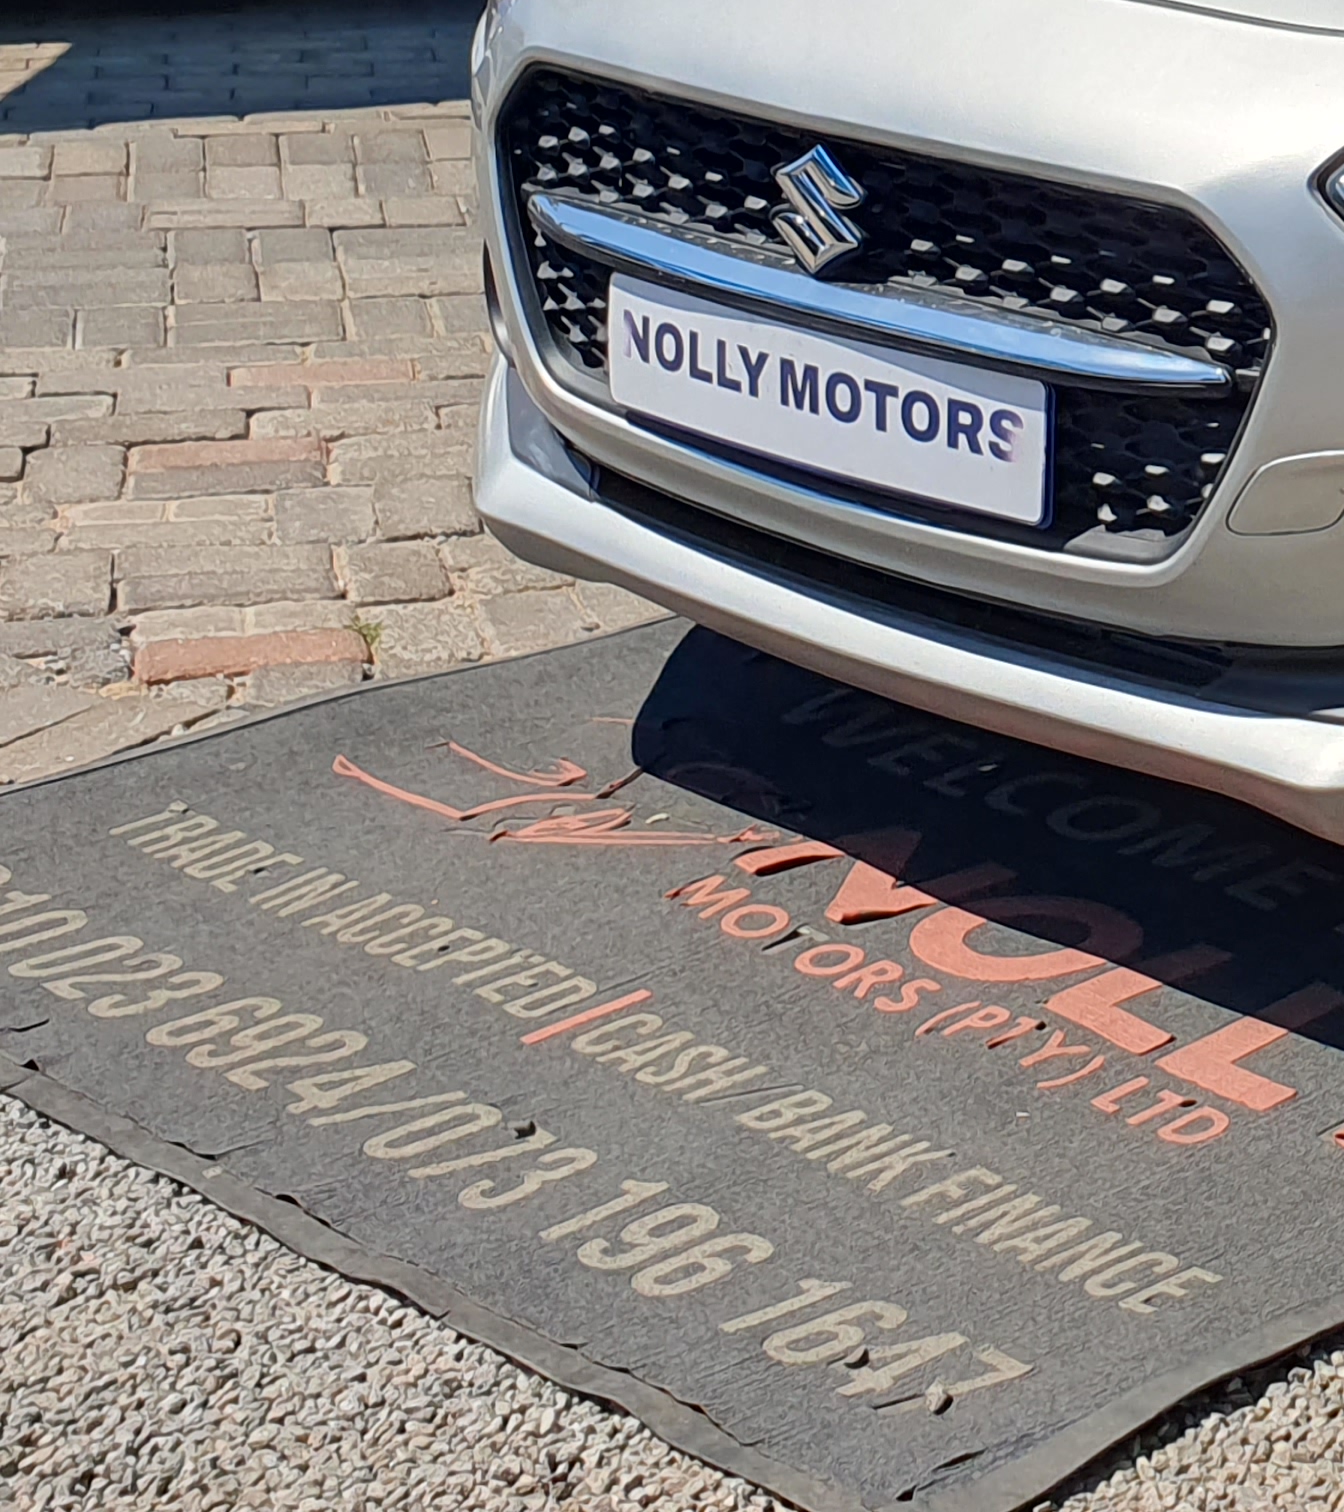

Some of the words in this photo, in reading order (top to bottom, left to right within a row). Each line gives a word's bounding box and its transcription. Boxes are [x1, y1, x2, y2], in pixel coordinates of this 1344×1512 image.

[622, 308, 768, 400] NOLLY
[778, 357, 1025, 464] MOTORS
[108, 799, 304, 893] TRADE
[781, 688, 1343, 911] WELCOME
[249, 866, 361, 918] IN
[300, 891, 598, 1019] ACCEPTED
[664, 874, 943, 1014] MOTORS
[914, 1001, 1106, 1089] (PTY)
[1090, 1076, 1230, 1144] LTD
[7, 935, 225, 1019] 023
[538, 1177, 776, 1298] 196
[718, 1277, 1035, 1415] 1647
[900, 1164, 1225, 1314] FINANCE
